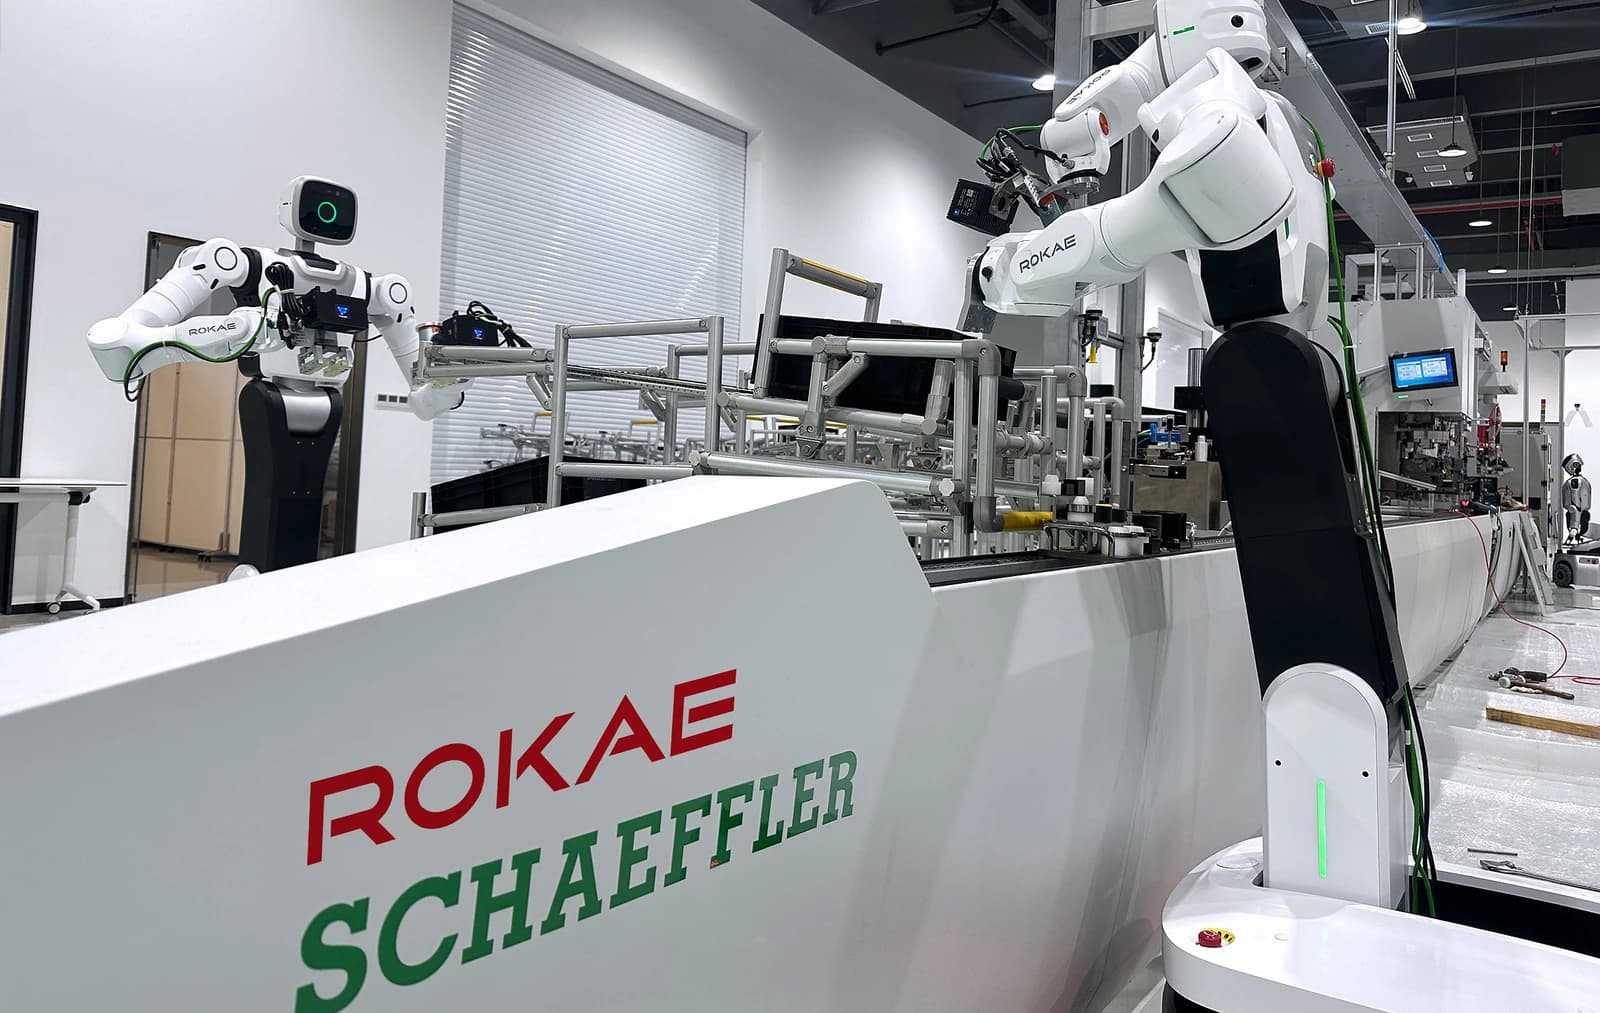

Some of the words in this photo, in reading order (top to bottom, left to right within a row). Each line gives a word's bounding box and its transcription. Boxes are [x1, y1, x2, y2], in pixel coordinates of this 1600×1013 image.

[1019, 234, 1077, 273] ROKAE
[189, 322, 237, 336] ROKAE
[307, 669, 737, 866] ROKAE
[294, 750, 858, 1013] SCHAEFFLER
